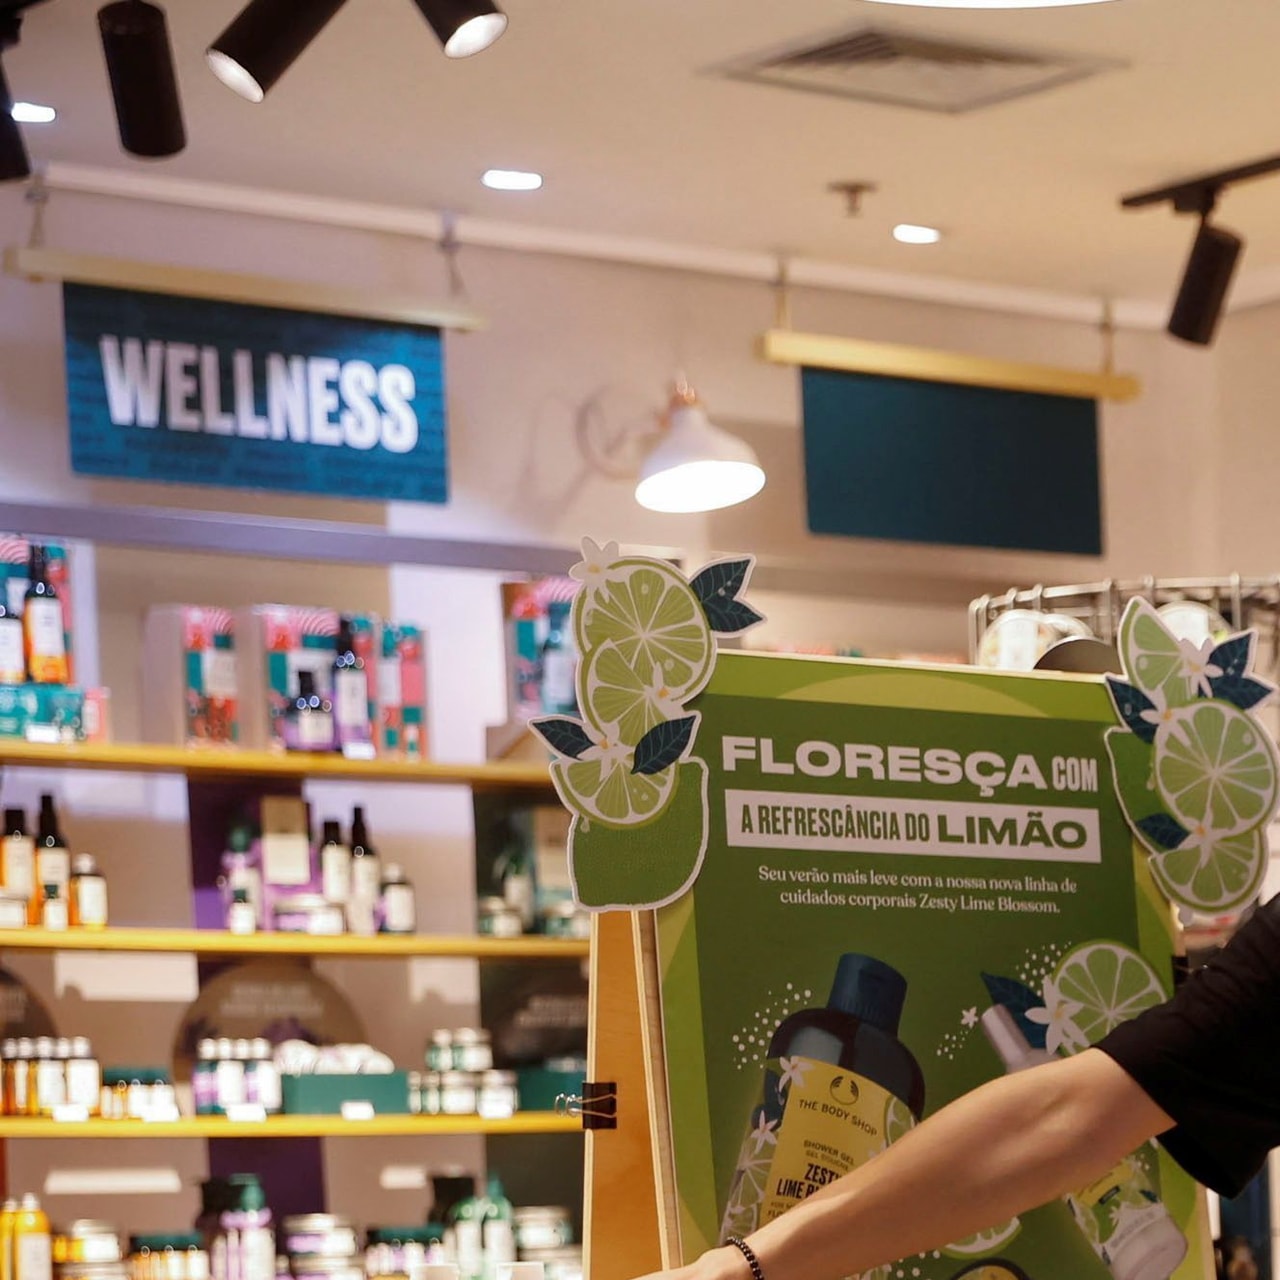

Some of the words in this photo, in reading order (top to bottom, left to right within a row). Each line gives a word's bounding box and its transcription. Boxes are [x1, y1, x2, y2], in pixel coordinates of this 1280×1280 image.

[100, 334, 419, 453] WELLNESS
[722, 735, 1047, 797] FLORESÇA
[1052, 756, 1098, 793] COM
[741, 804, 753, 834] A
[758, 805, 900, 841] REFRESCÂNCIA
[905, 813, 930, 842] DO
[937, 812, 1088, 849] LIMÃO
[758, 866, 787, 883] Seu
[787, 868, 830, 885] verão
[832, 870, 867, 886] mais
[870, 870, 898, 887] leve
[900, 874, 932, 888] com
[935, 878, 943, 889] a
[946, 877, 987, 890] nossa
[989, 878, 1023, 892] nova
[1025, 877, 1058, 893] linha
[1061, 878, 1077, 894] de
[780, 889, 846, 907] cuidados
[849, 892, 916, 911] corporais
[919, 894, 958, 914] Zesty
[960, 895, 995, 911] Lime
[998, 897, 1060, 914] Blossom.
[799, 1099, 818, 1111] THE
[821, 1103, 850, 1120] BODY
[852, 1115, 878, 1136] SHOP
[804, 1140, 839, 1157] SHOWER
[840, 1151, 855, 1165] GEL
[776, 1178, 805, 1199] LIME
